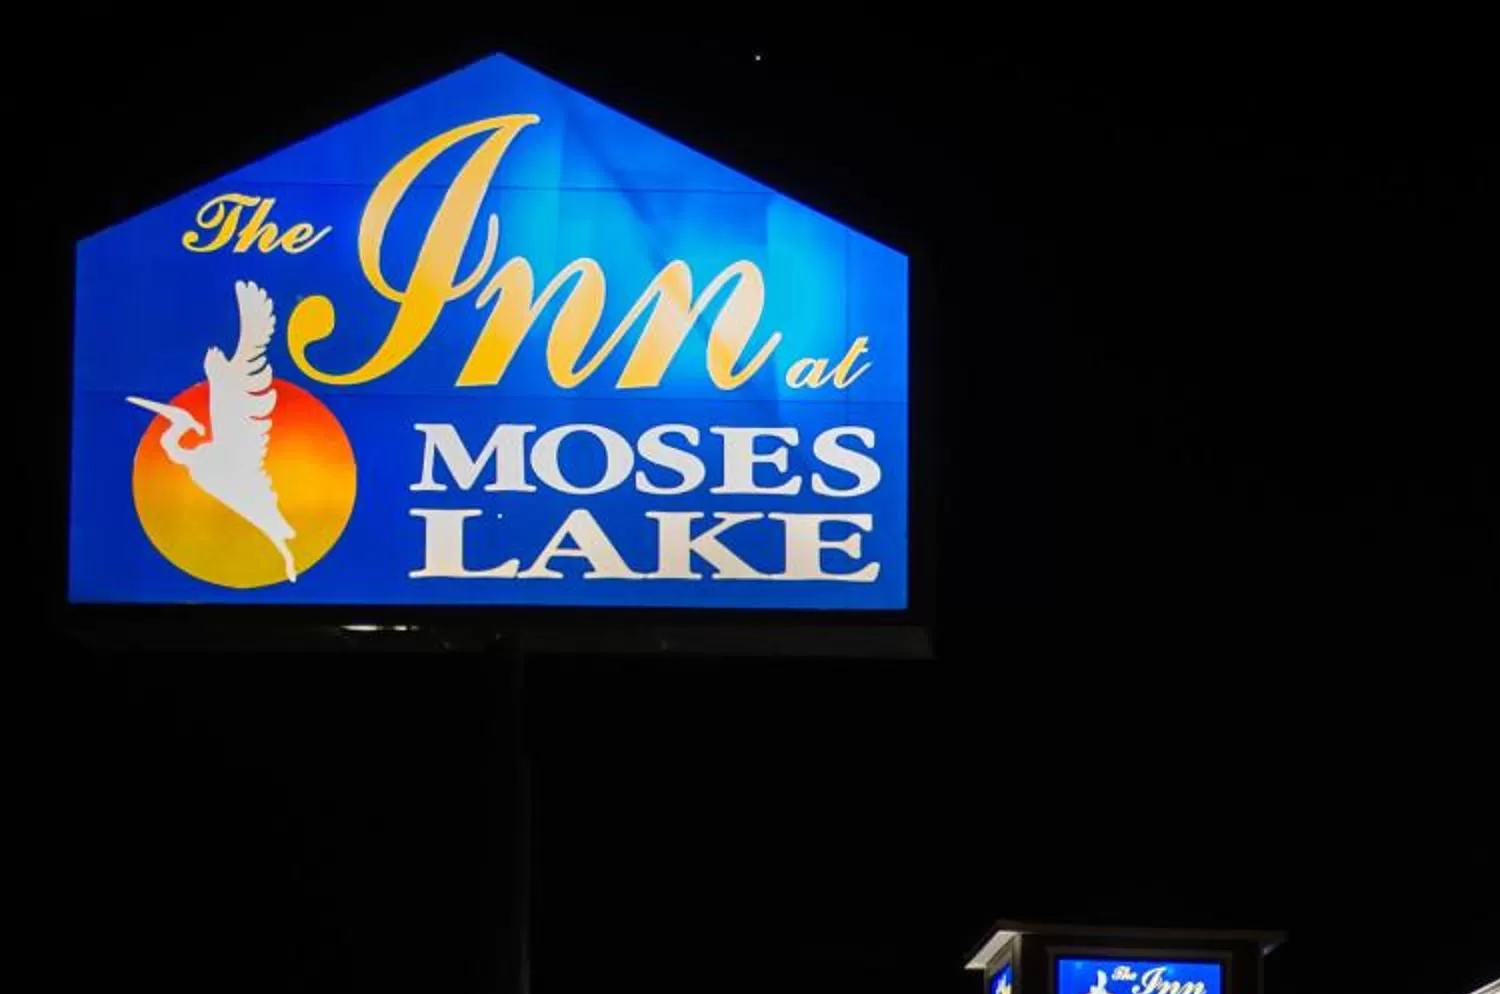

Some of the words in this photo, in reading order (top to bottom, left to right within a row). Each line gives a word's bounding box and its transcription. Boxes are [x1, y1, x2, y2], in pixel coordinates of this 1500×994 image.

[182, 193, 331, 254] The
[287, 113, 782, 390] Inn
[785, 335, 871, 389] at
[410, 422, 882, 497] MOSES
[410, 508, 882, 582] LAKE
[1112, 965, 1137, 981] The
